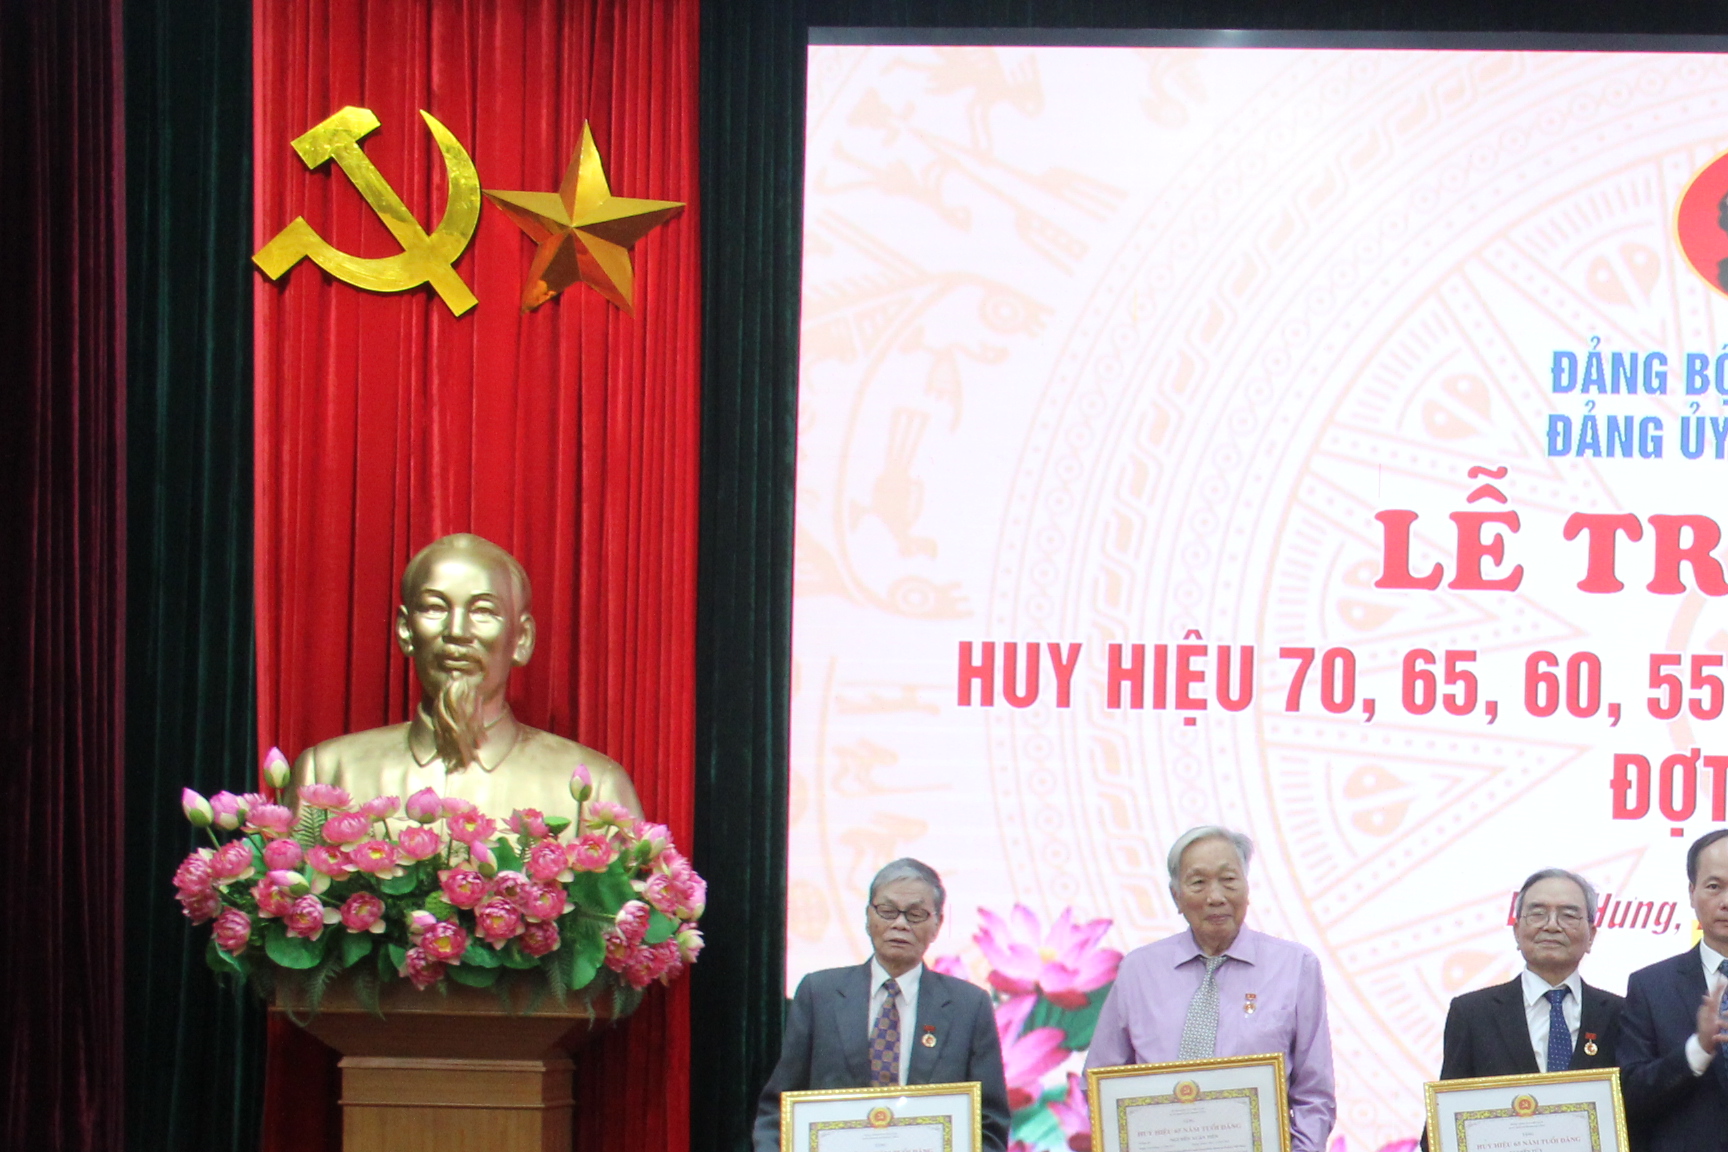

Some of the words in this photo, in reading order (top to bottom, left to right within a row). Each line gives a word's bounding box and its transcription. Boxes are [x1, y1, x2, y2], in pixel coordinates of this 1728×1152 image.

[1551, 336, 1668, 395] ĐẢNG
[1547, 400, 1664, 459] ĐẢNG
[1374, 465, 1524, 592] LỄ
[958, 641, 1082, 710] HUY
[1107, 628, 1254, 726] HIỆU
[1280, 647, 1377, 723] 70,
[1402, 648, 1499, 725] 65,
[1525, 650, 1622, 727] 60,
